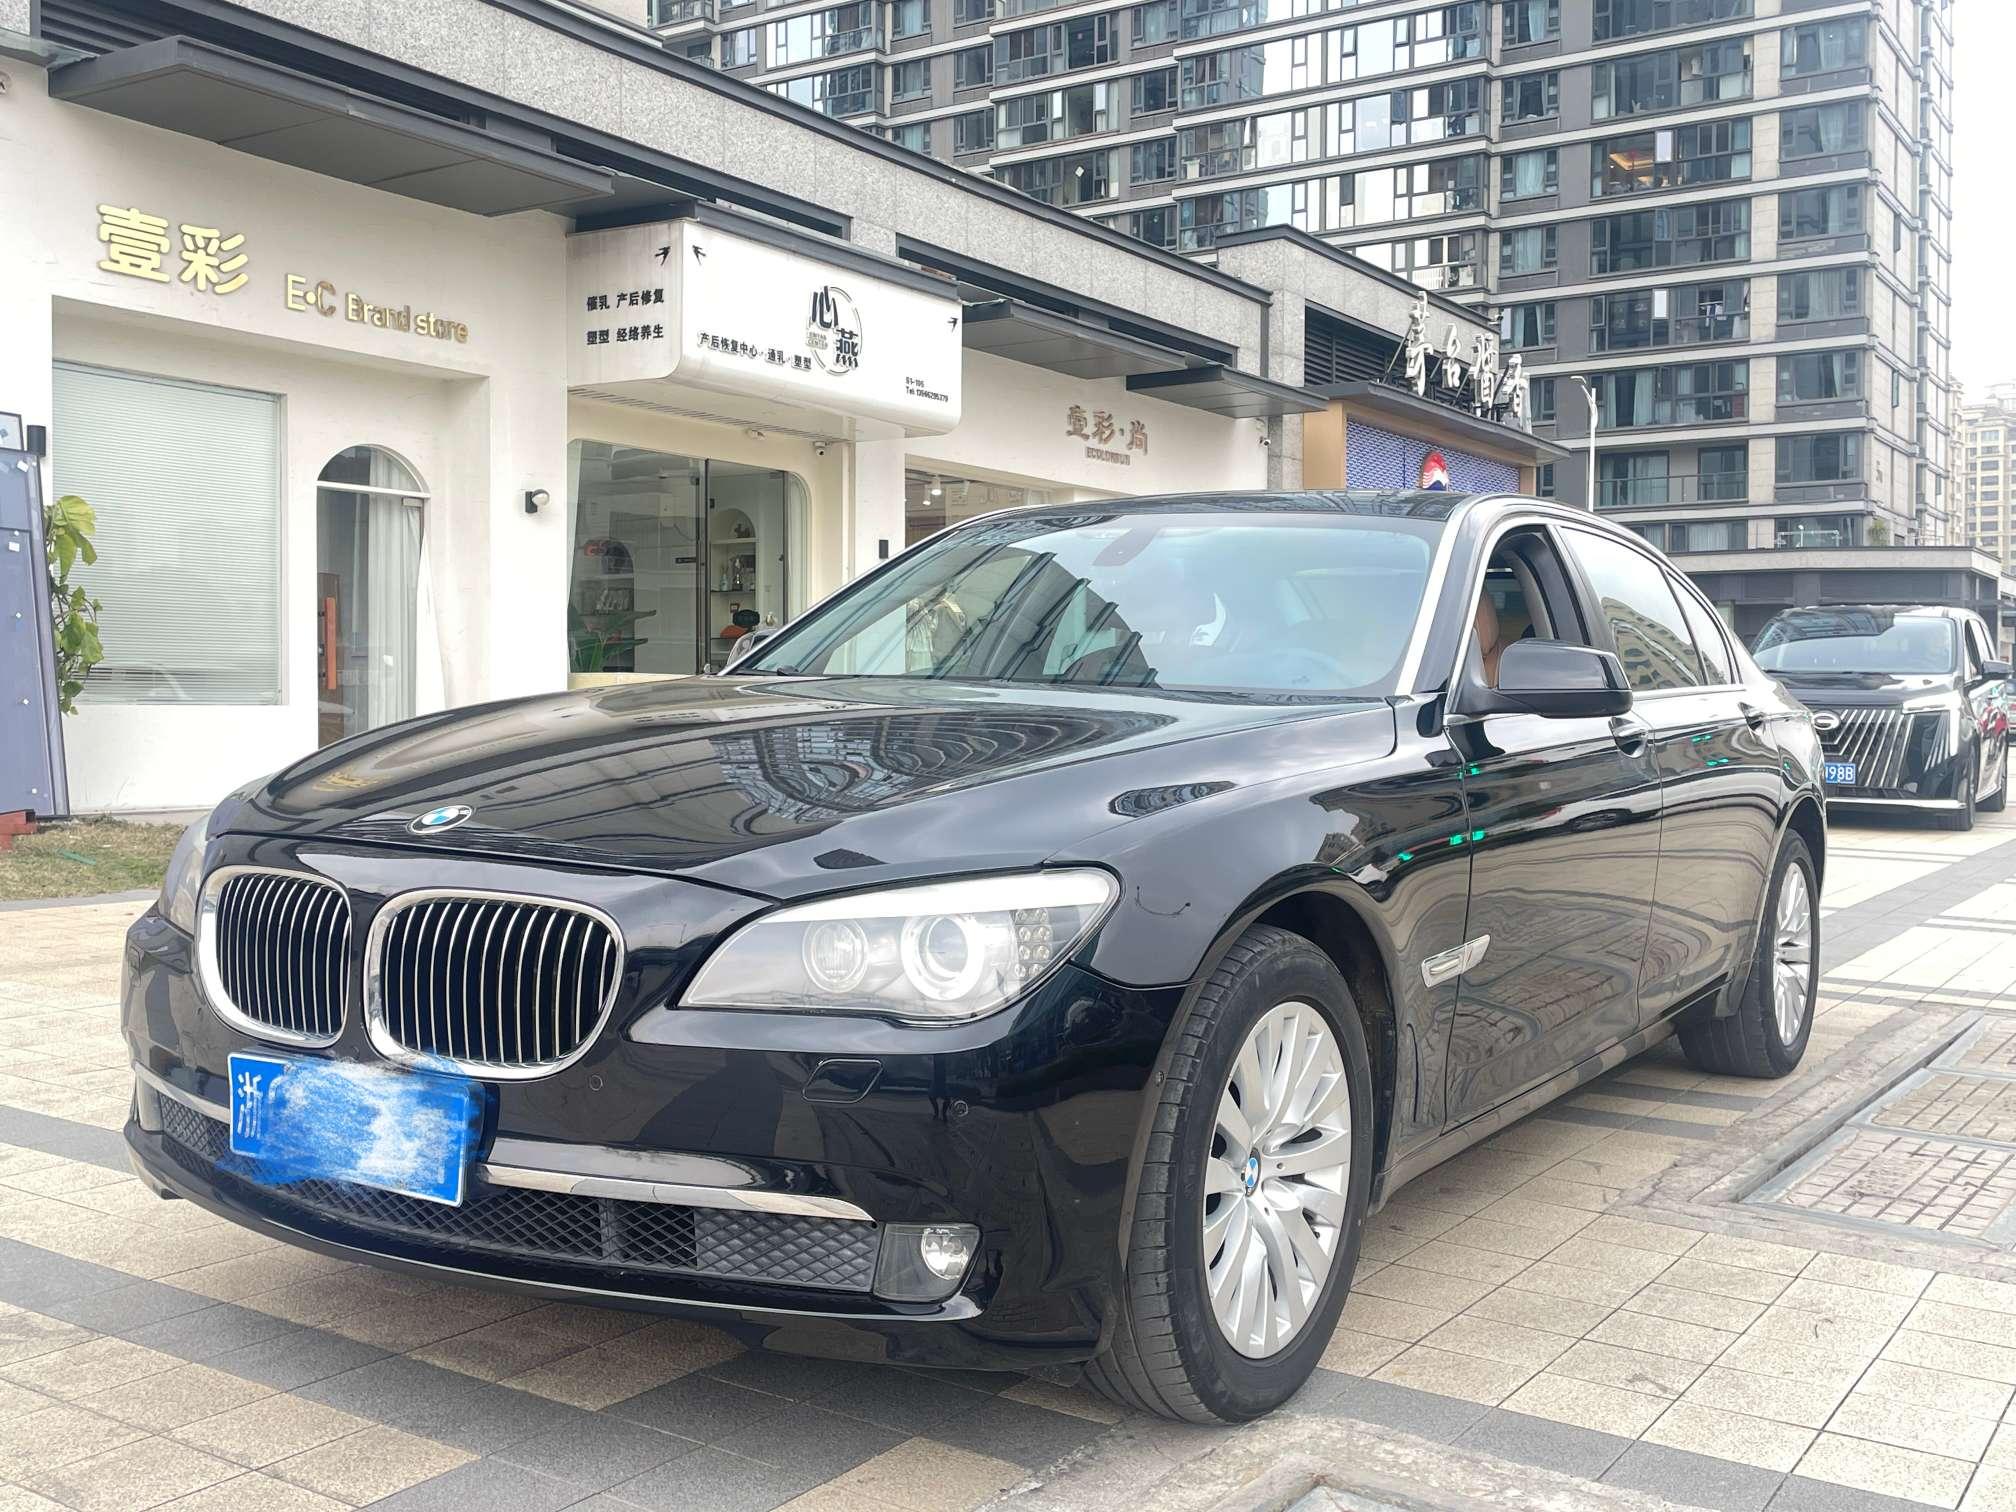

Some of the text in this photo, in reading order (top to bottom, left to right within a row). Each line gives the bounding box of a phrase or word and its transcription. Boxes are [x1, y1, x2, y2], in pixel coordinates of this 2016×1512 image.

[98, 203, 249, 294] 壹彩
[345, 292, 411, 333] Brand
[414, 312, 469, 343] store
[586, 288, 665, 312] 催乳 产后修复
[586, 323, 664, 345] 塑型 经络养生
[811, 285, 859, 368] 心燕
